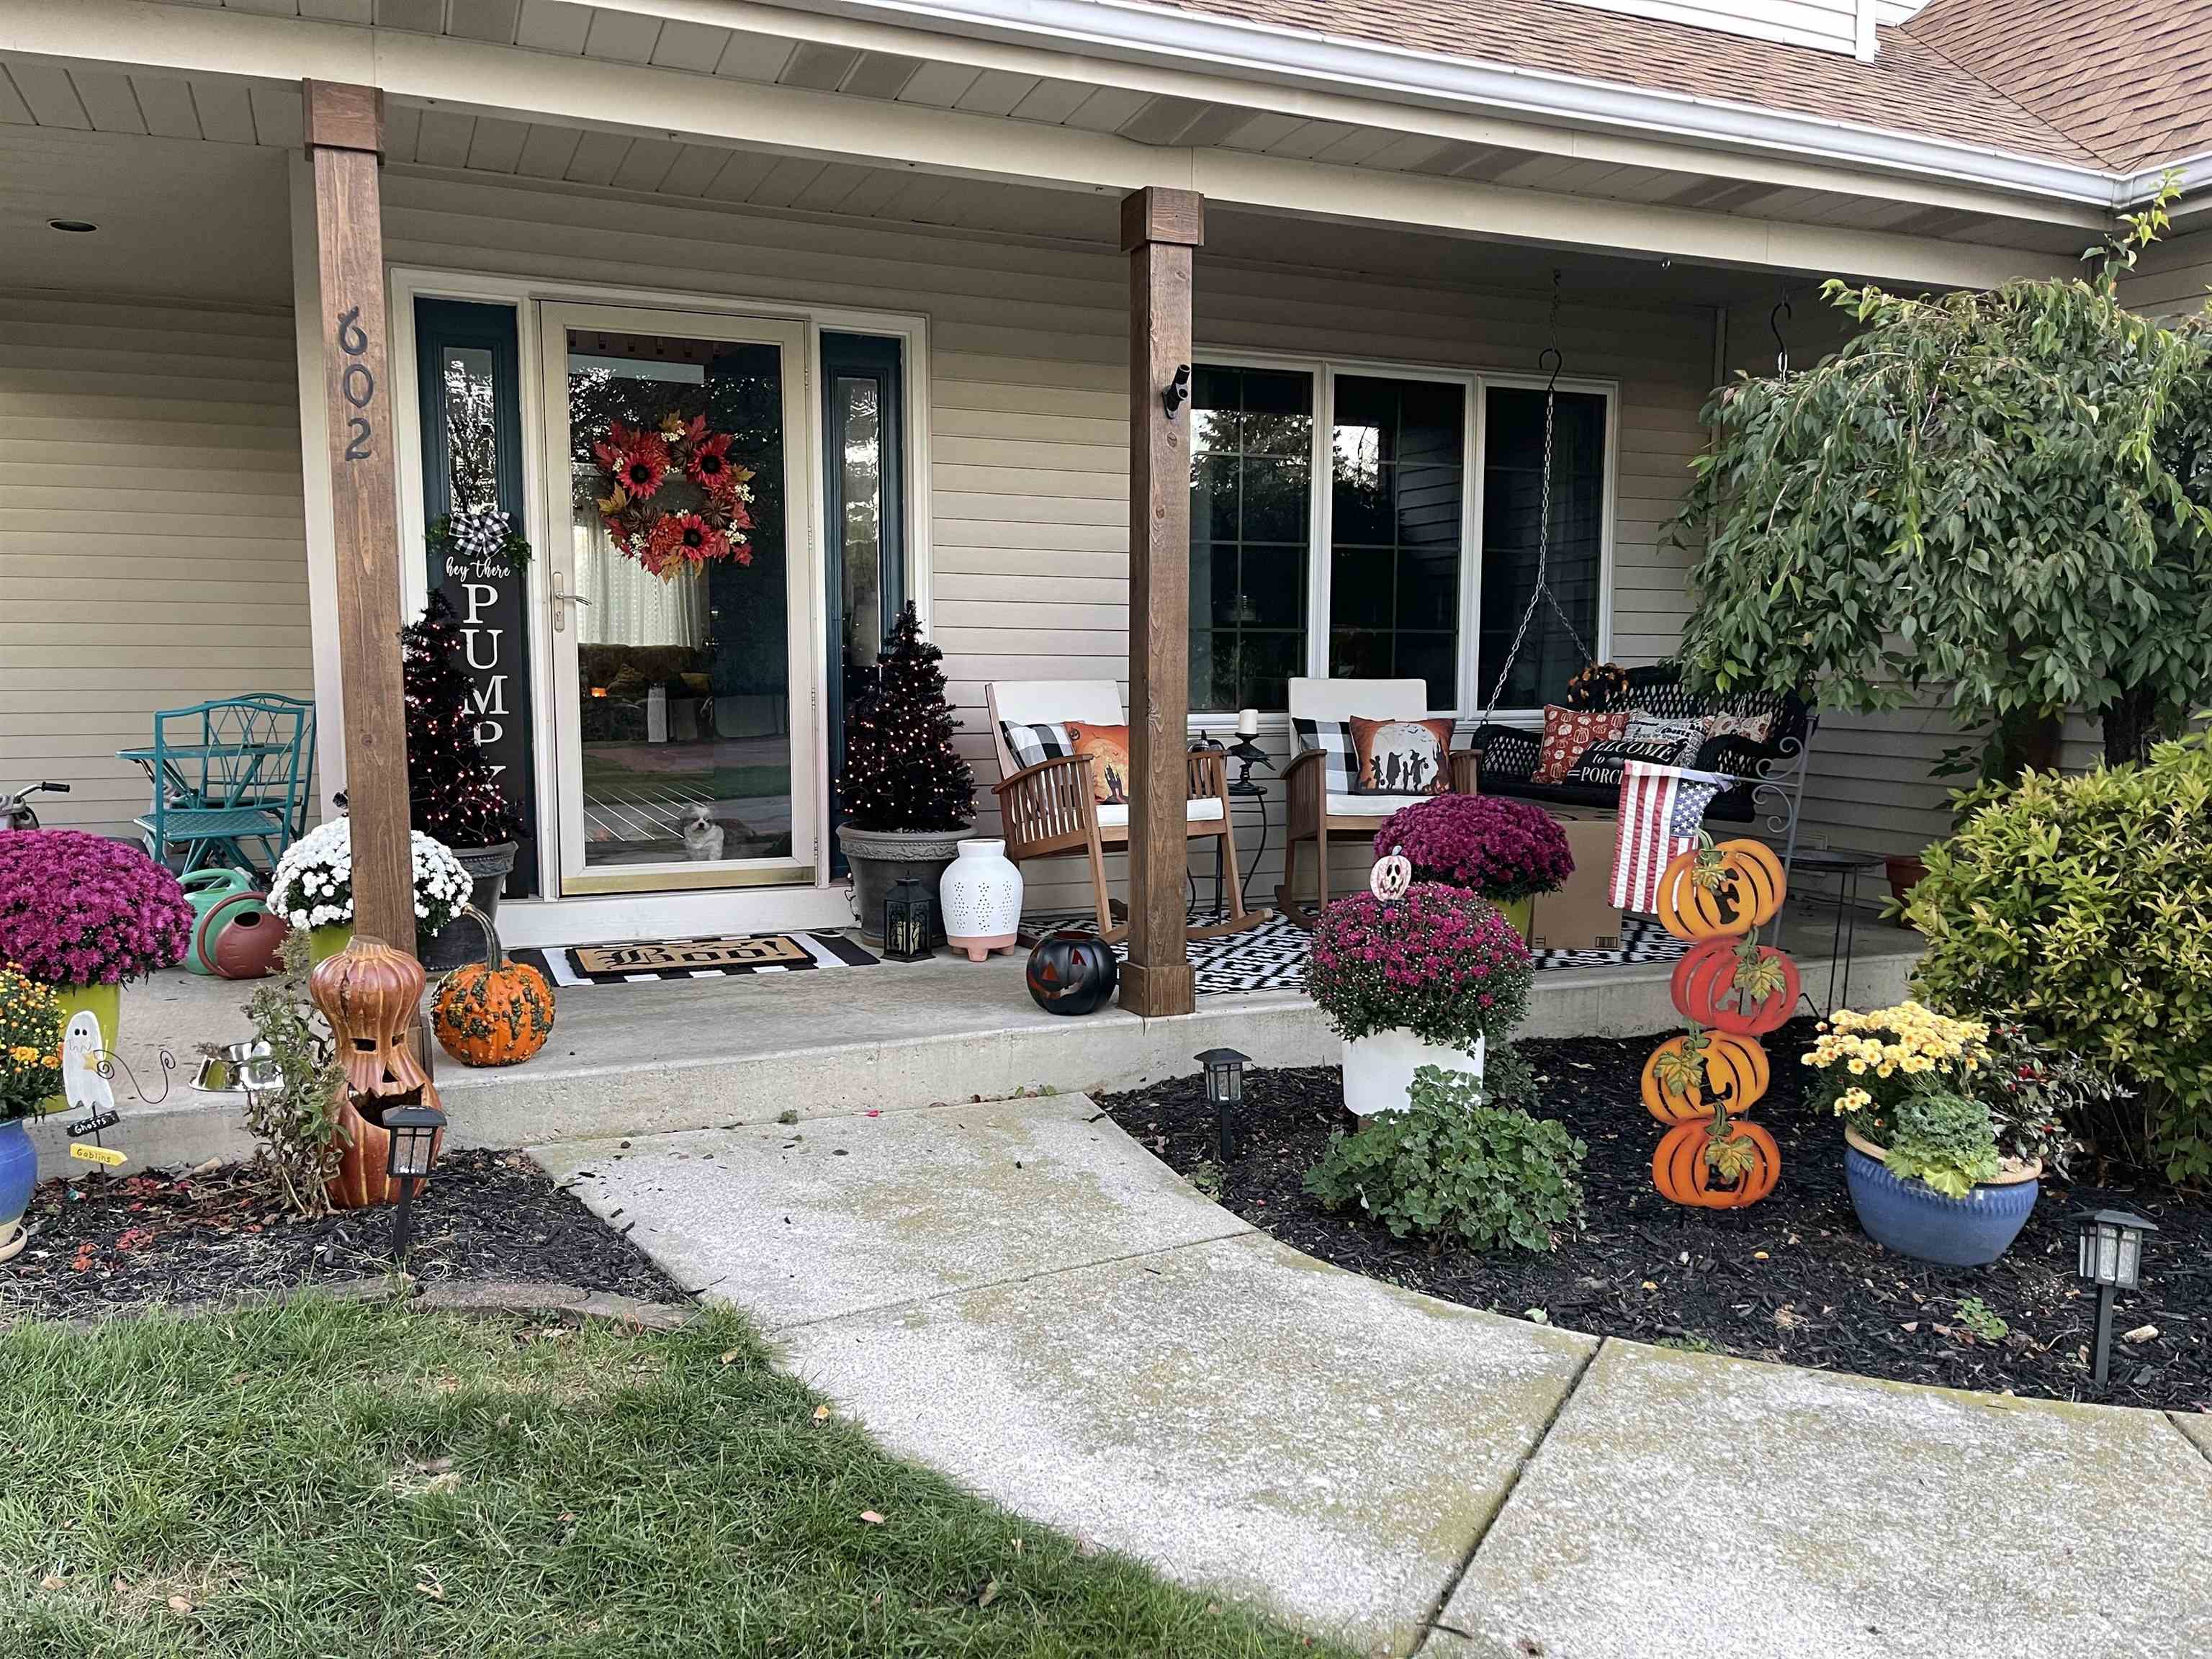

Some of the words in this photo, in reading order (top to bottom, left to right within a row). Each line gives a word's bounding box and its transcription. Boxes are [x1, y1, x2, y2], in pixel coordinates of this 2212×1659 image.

[338, 305, 374, 462] 602
[446, 556, 469, 582] hey
[470, 557, 511, 578] there
[1593, 753, 1606, 764] to
[594, 940, 788, 970] Boo!
[74, 1117, 107, 1134] Ghosts
[76, 1148, 112, 1163] Goblins
